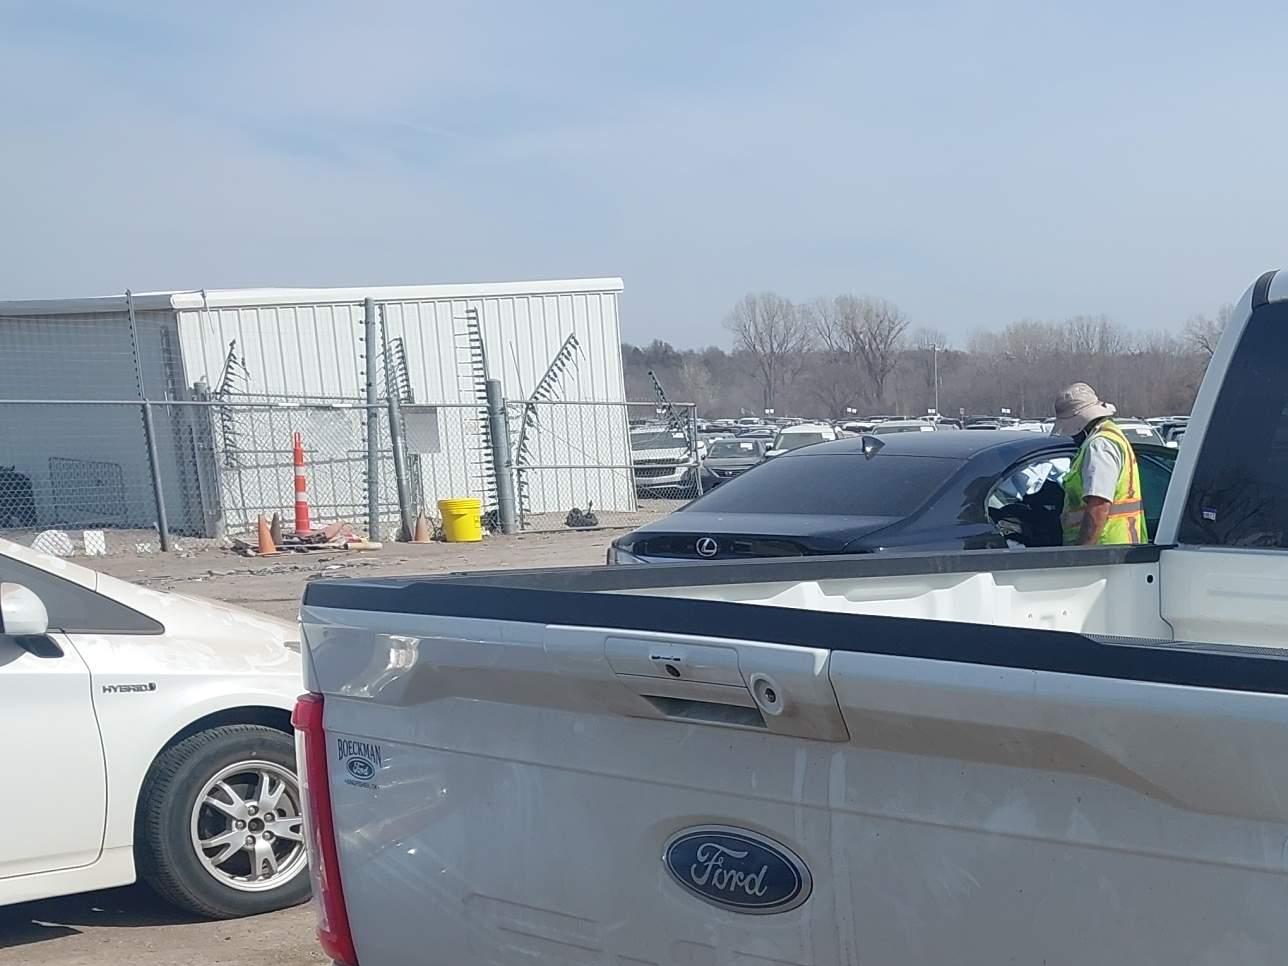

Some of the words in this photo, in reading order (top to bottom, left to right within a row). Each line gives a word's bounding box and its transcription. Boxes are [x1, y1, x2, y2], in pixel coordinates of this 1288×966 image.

[102, 684, 148, 693] HYBRID
[337, 738, 382, 769] BOECKMAN
[690, 842, 769, 898] Ford
